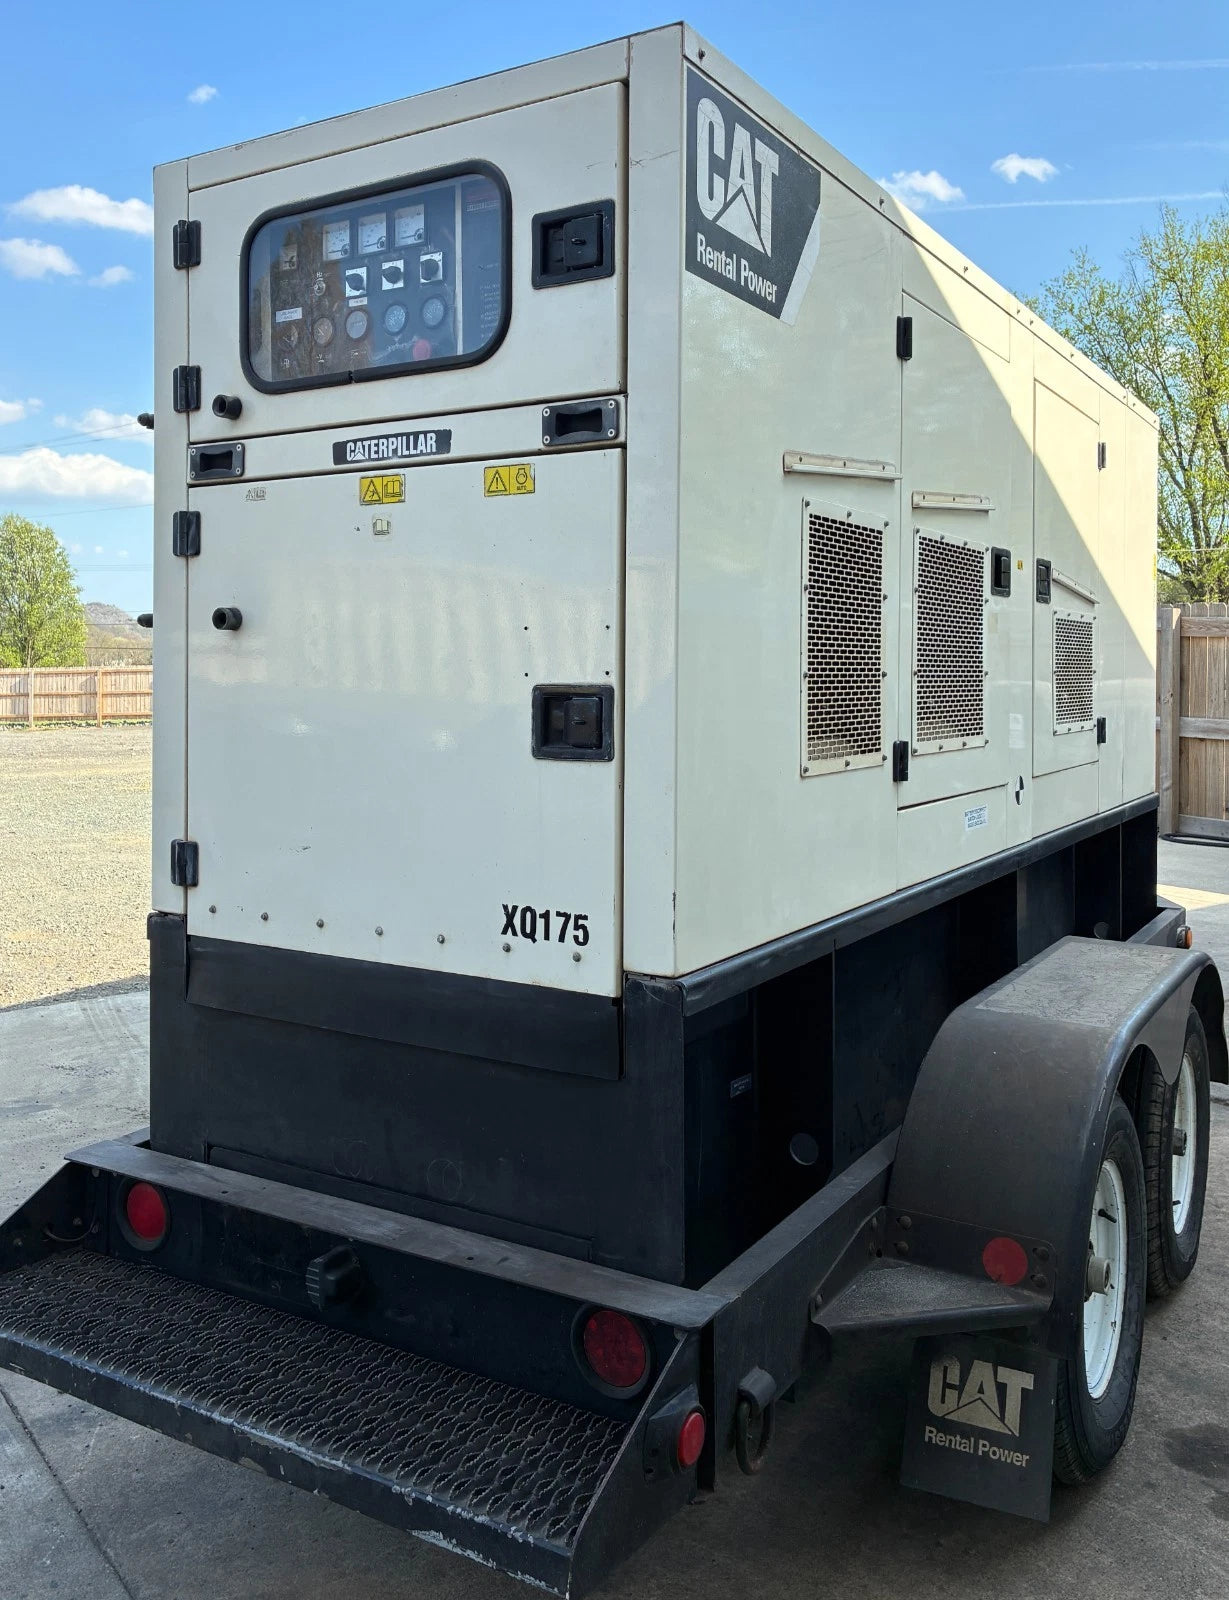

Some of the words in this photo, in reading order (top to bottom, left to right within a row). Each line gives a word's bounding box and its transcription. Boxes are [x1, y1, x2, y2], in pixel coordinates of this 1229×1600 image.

[696, 97, 779, 257] CAT
[696, 233, 737, 280] Rental
[740, 258, 777, 303] Power
[346, 432, 437, 461] CATERPILLAR
[501, 903, 589, 947] XQ175
[927, 1355, 1034, 1437] CAT
[924, 1425, 974, 1454] Rental
[978, 1439, 1029, 1468] Power
